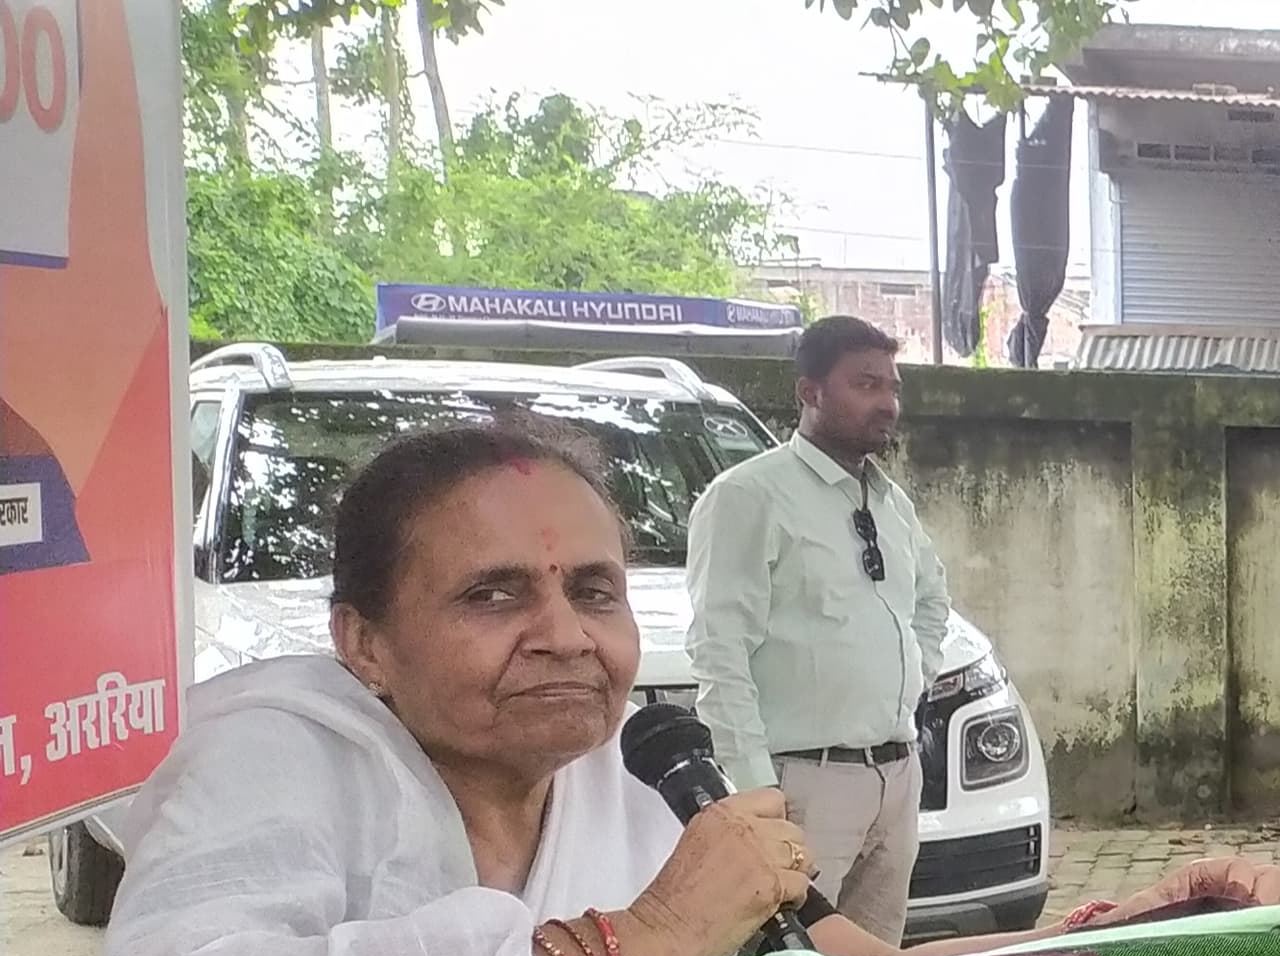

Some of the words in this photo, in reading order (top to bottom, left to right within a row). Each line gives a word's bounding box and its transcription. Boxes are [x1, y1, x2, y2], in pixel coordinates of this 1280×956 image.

[447, 294, 567, 318] MAHAKALI
[572, 300, 683, 323] HYUNDAI
[44, 670, 168, 764] अररिया
